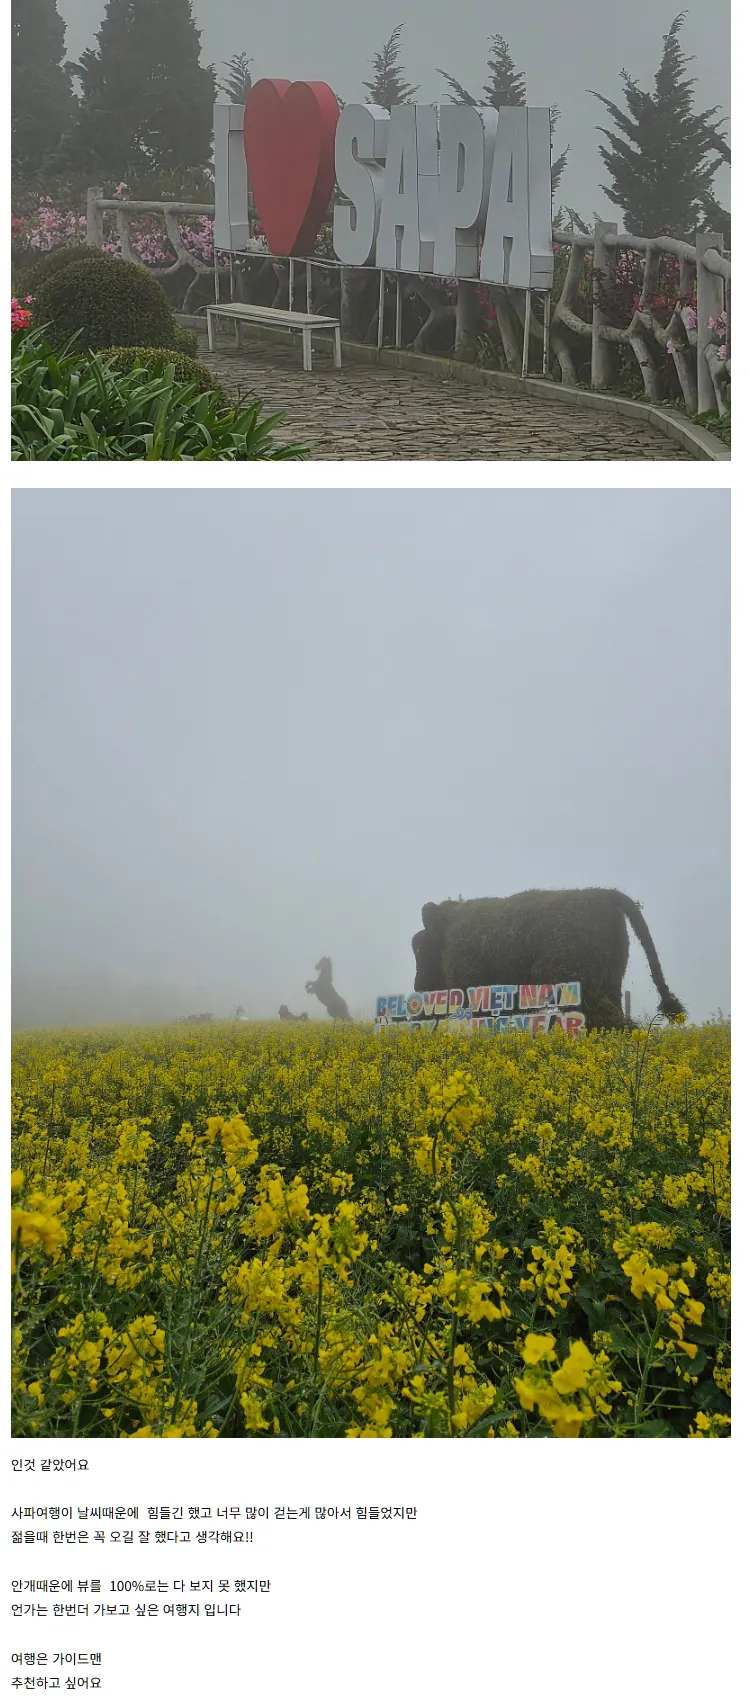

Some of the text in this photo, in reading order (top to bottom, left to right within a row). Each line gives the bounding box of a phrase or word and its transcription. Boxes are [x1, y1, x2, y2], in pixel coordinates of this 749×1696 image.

[213, 102, 554, 288] I SAPA
[375, 988, 464, 1018] BELOVED
[518, 981, 580, 1009] NAM
